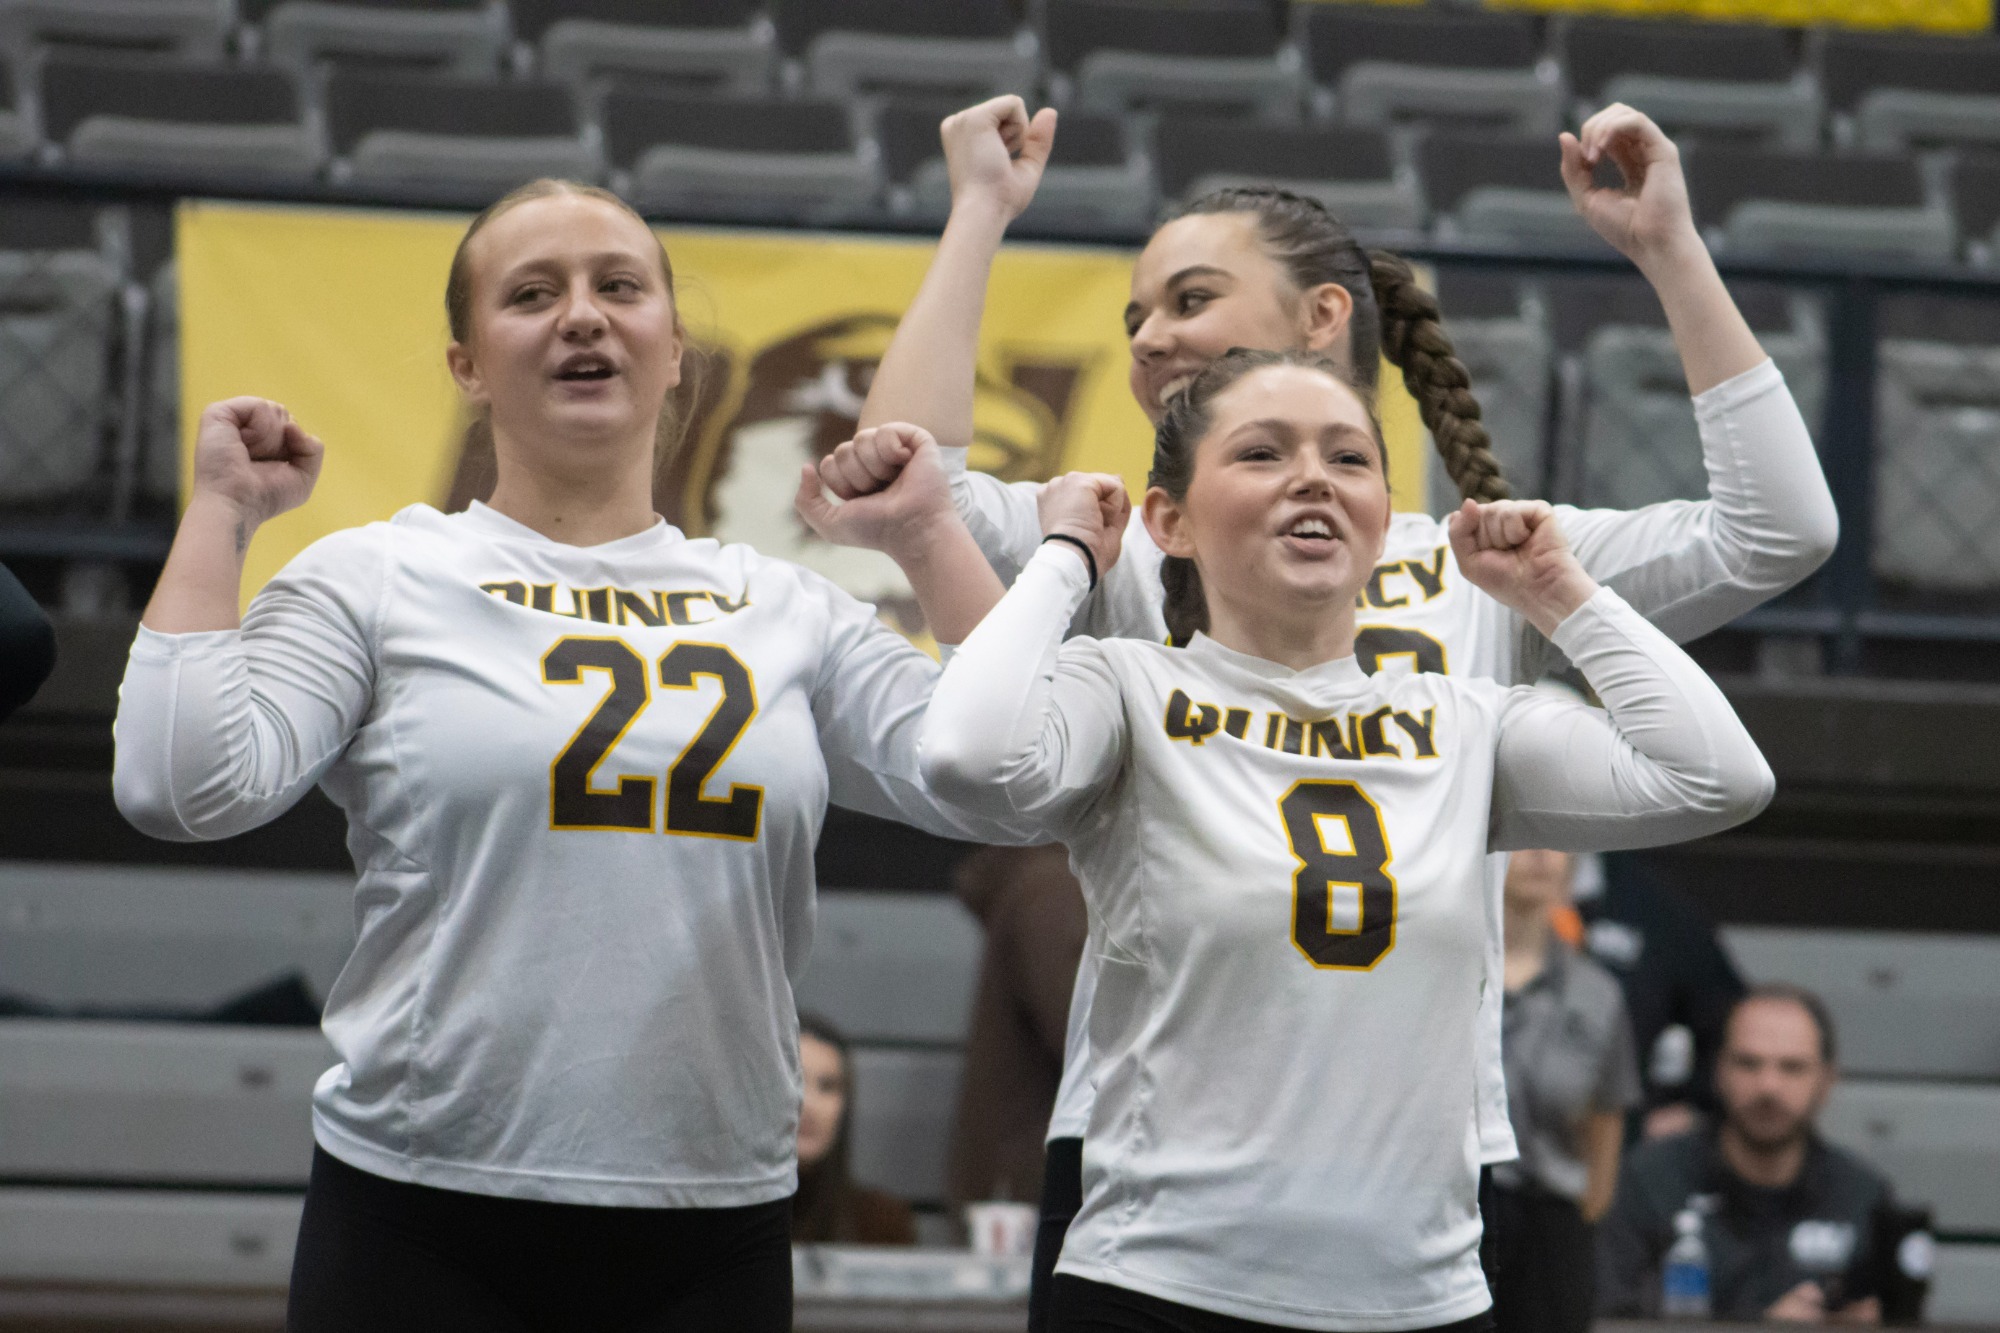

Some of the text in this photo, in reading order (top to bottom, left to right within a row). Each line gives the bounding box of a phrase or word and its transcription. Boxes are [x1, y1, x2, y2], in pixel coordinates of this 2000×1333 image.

[540, 635, 764, 843] 22
[1164, 688, 1440, 760] QUINCY
[1277, 778, 1398, 972] 8
